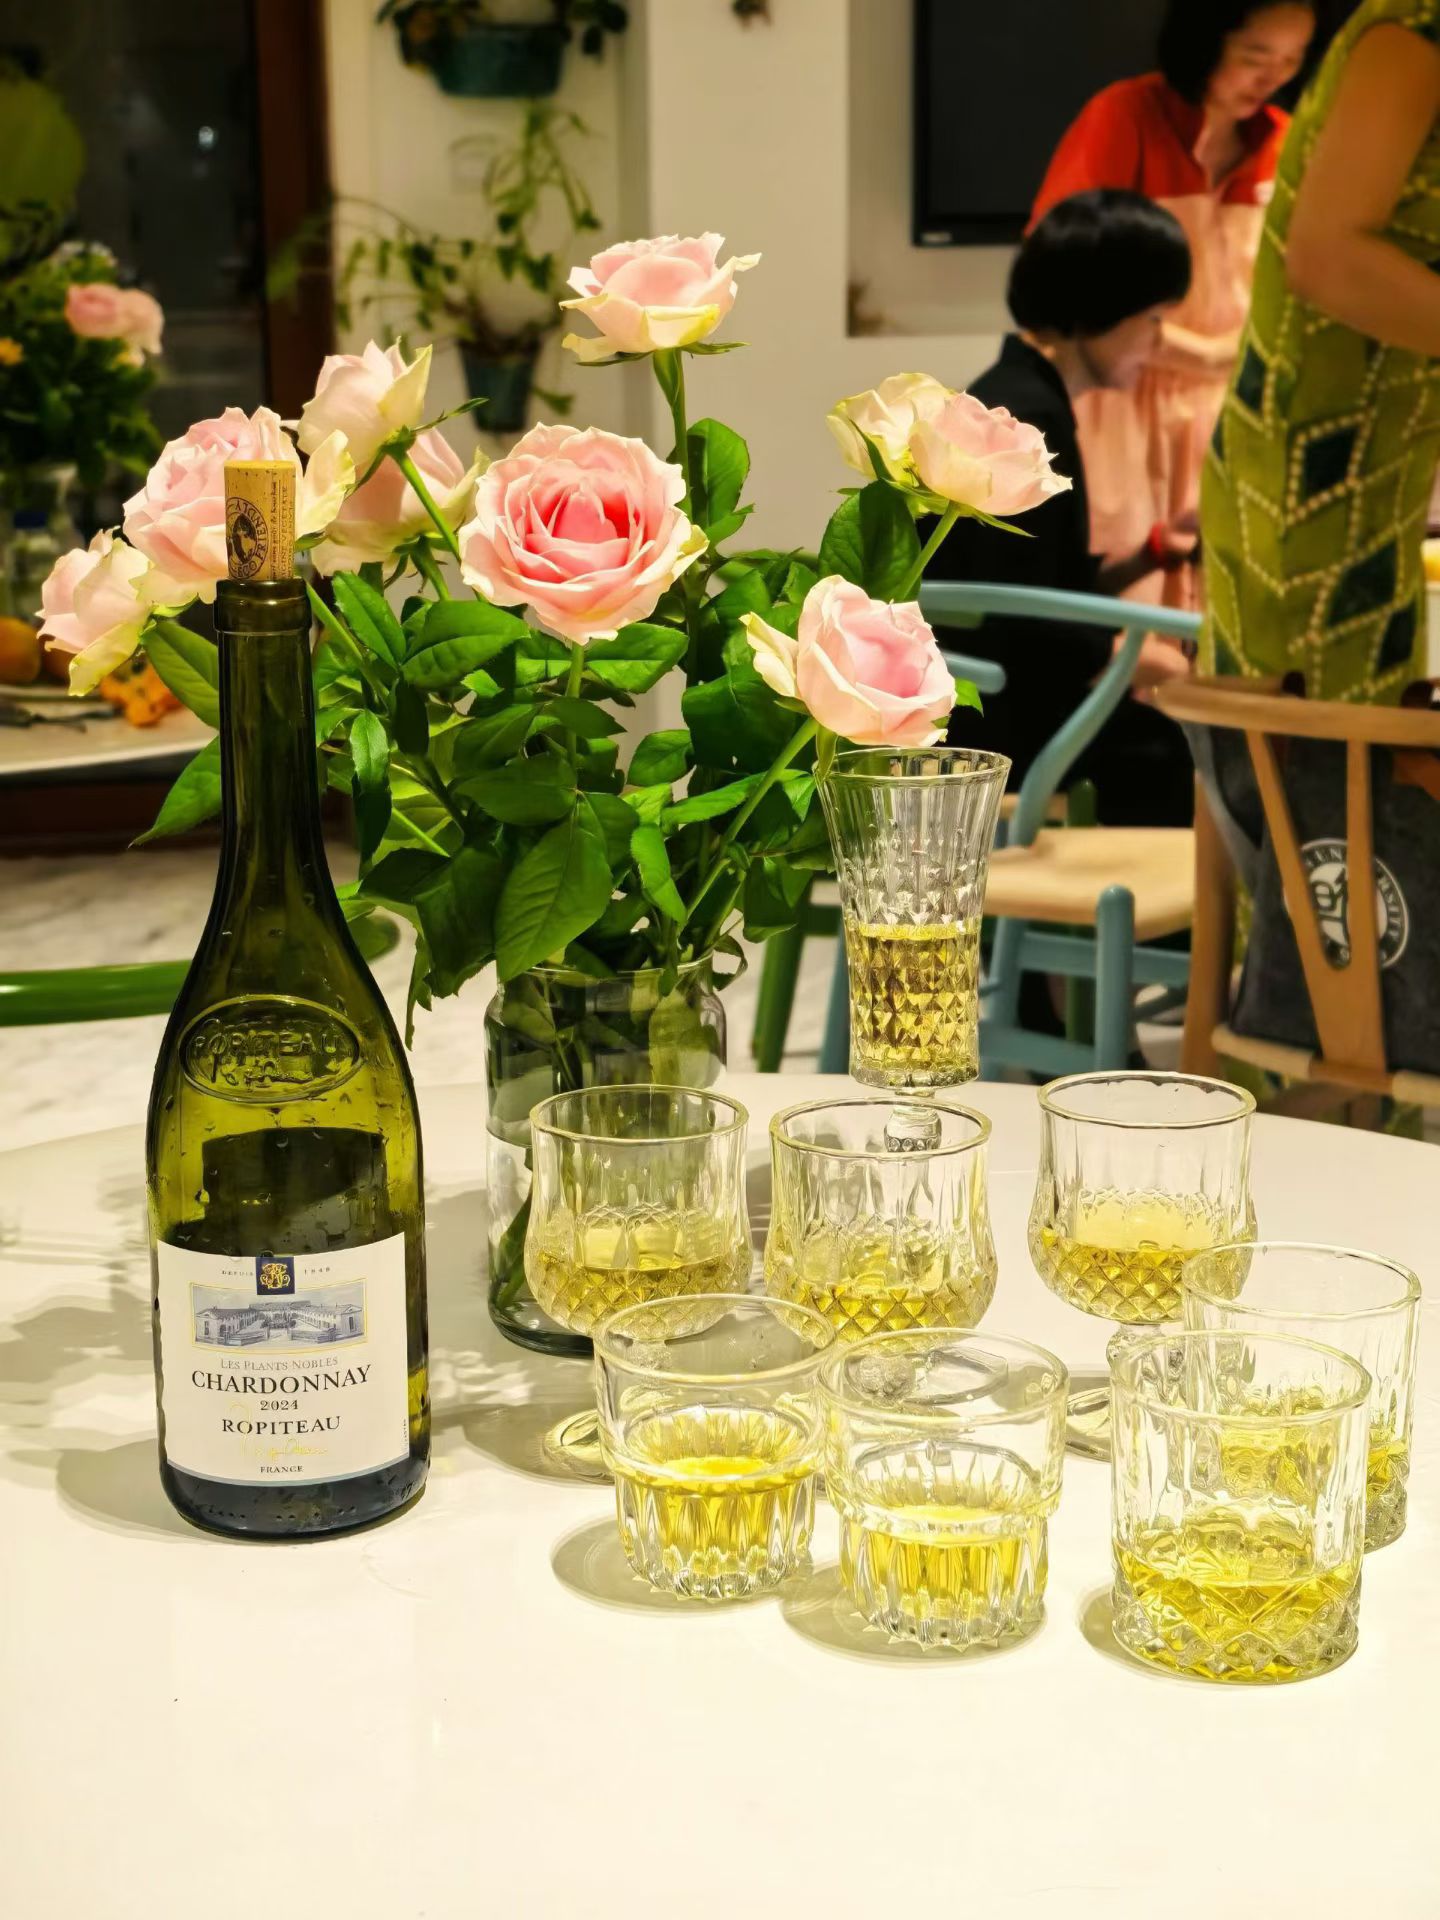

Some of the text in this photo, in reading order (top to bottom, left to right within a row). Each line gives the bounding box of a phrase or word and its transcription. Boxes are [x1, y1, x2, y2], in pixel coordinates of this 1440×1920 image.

[220, 1357, 338, 1371] LES PLANTS NOBLES
[191, 1364, 372, 1394] CHARDONNAY
[260, 1400, 299, 1411] 2024
[221, 1416, 341, 1434] ROPITEAU
[260, 1466, 304, 1474] FRANCE
